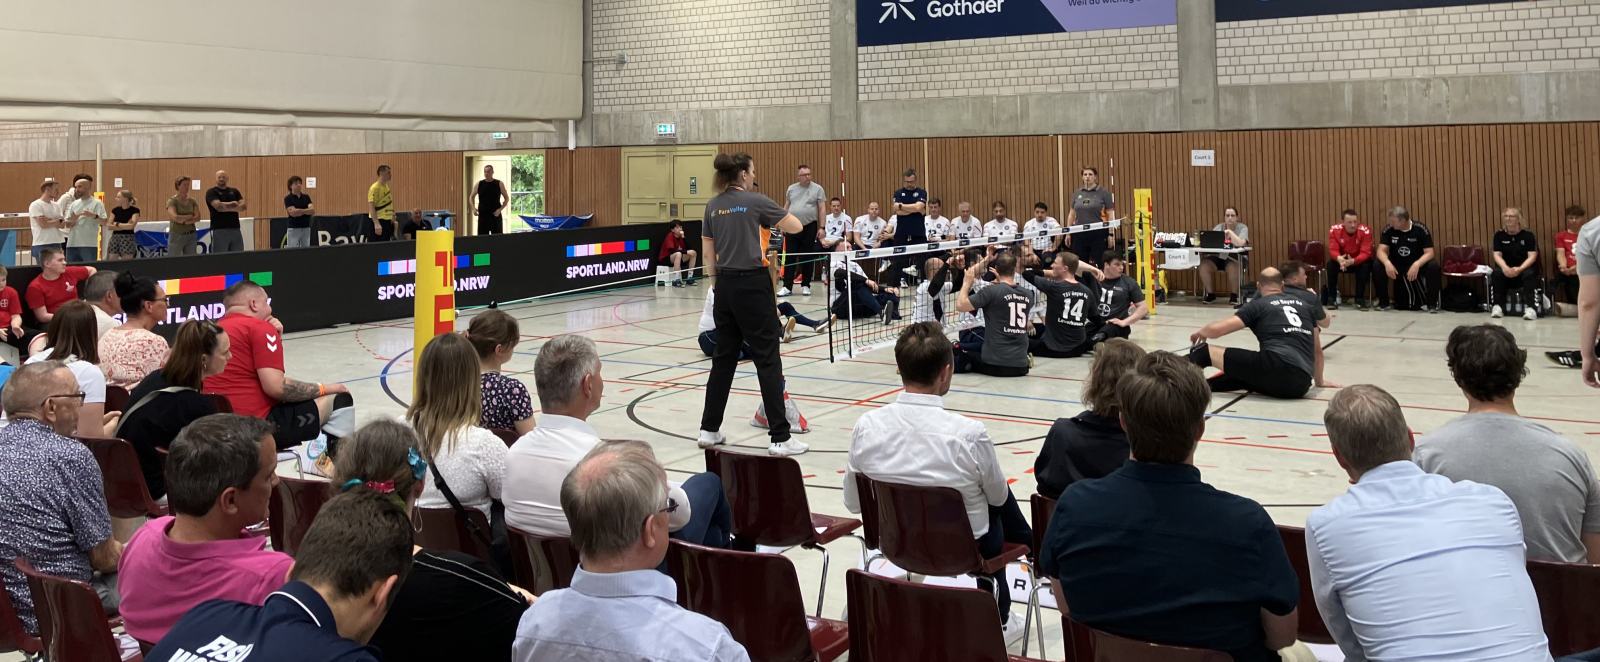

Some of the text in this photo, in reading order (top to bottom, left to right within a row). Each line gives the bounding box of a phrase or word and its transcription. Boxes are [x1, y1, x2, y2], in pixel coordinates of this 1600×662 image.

[926, 0, 1004, 18] Gothaer
[718, 206, 748, 215] ParaVolley
[317, 230, 368, 247] Bay
[830, 227, 837, 236] 2
[867, 231, 873, 240] 7
[566, 258, 650, 279] SPORTLAND.NRW
[377, 275, 490, 301] SPOR.NRW
[1100, 287, 1114, 305] 11
[1008, 302, 1027, 328] 15
[1062, 298, 1085, 321] 14
[1282, 306, 1303, 328] 6
